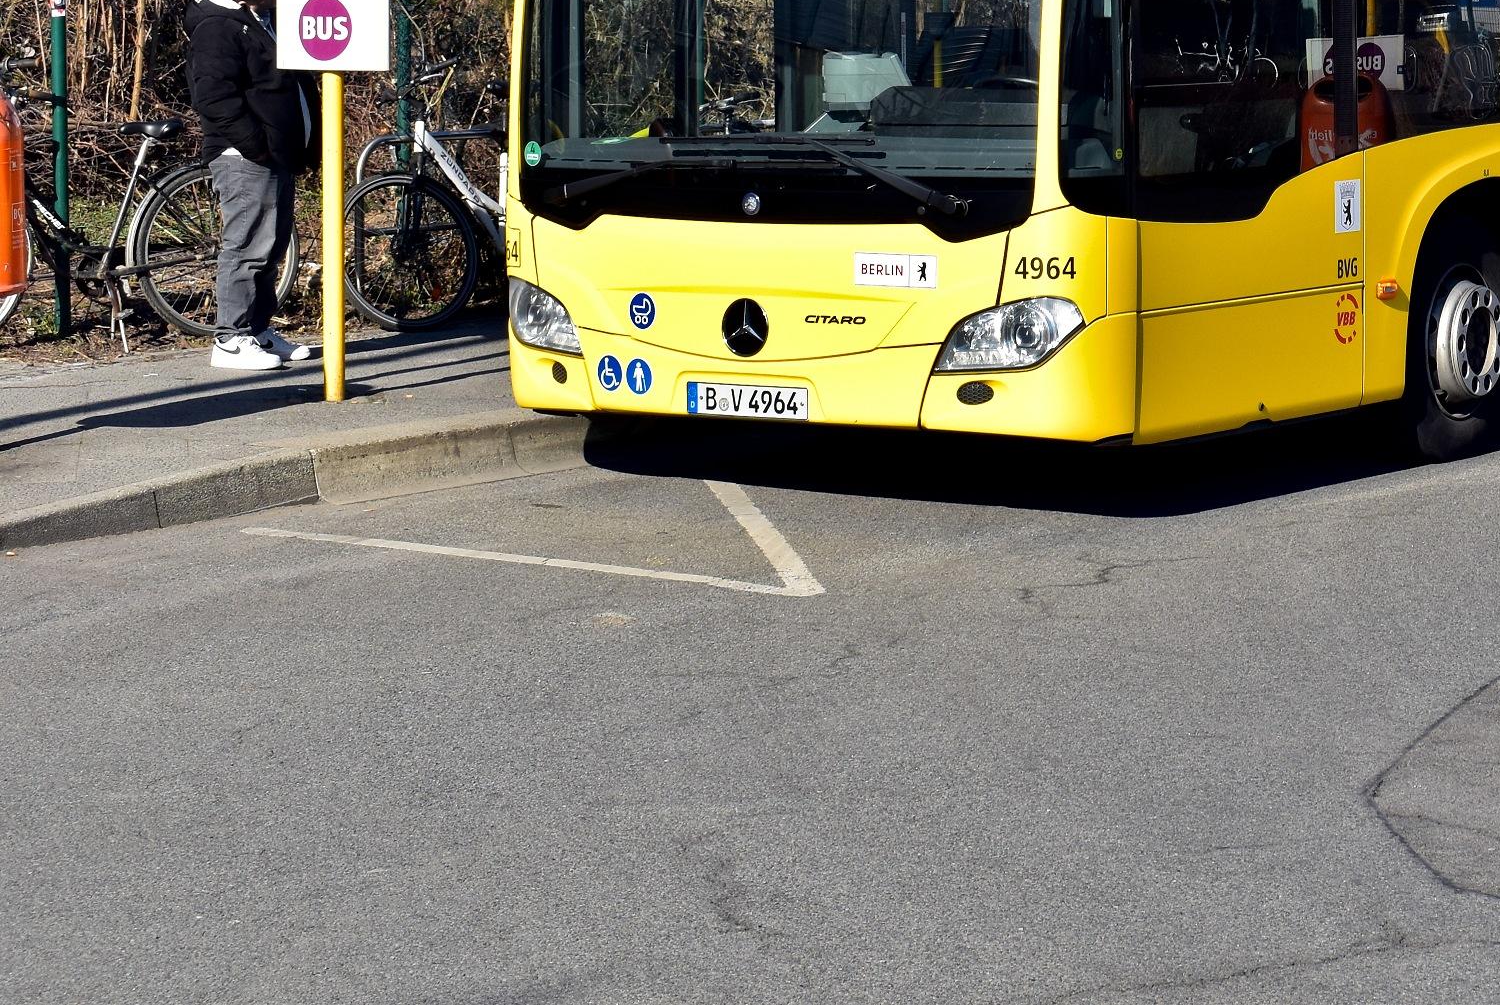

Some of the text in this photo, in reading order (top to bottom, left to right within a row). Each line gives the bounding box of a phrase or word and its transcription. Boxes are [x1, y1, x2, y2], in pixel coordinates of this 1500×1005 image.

[302, 15, 349, 41] BUS
[861, 263, 904, 277] BERLIN
[1014, 256, 1077, 280] 4964
[1337, 257, 1358, 279] BVG
[804, 314, 867, 326] CITARO
[1336, 311, 1356, 327] VBB
[706, 387, 717, 411] B
[731, 388, 743, 412] V
[748, 389, 799, 415] 4964
